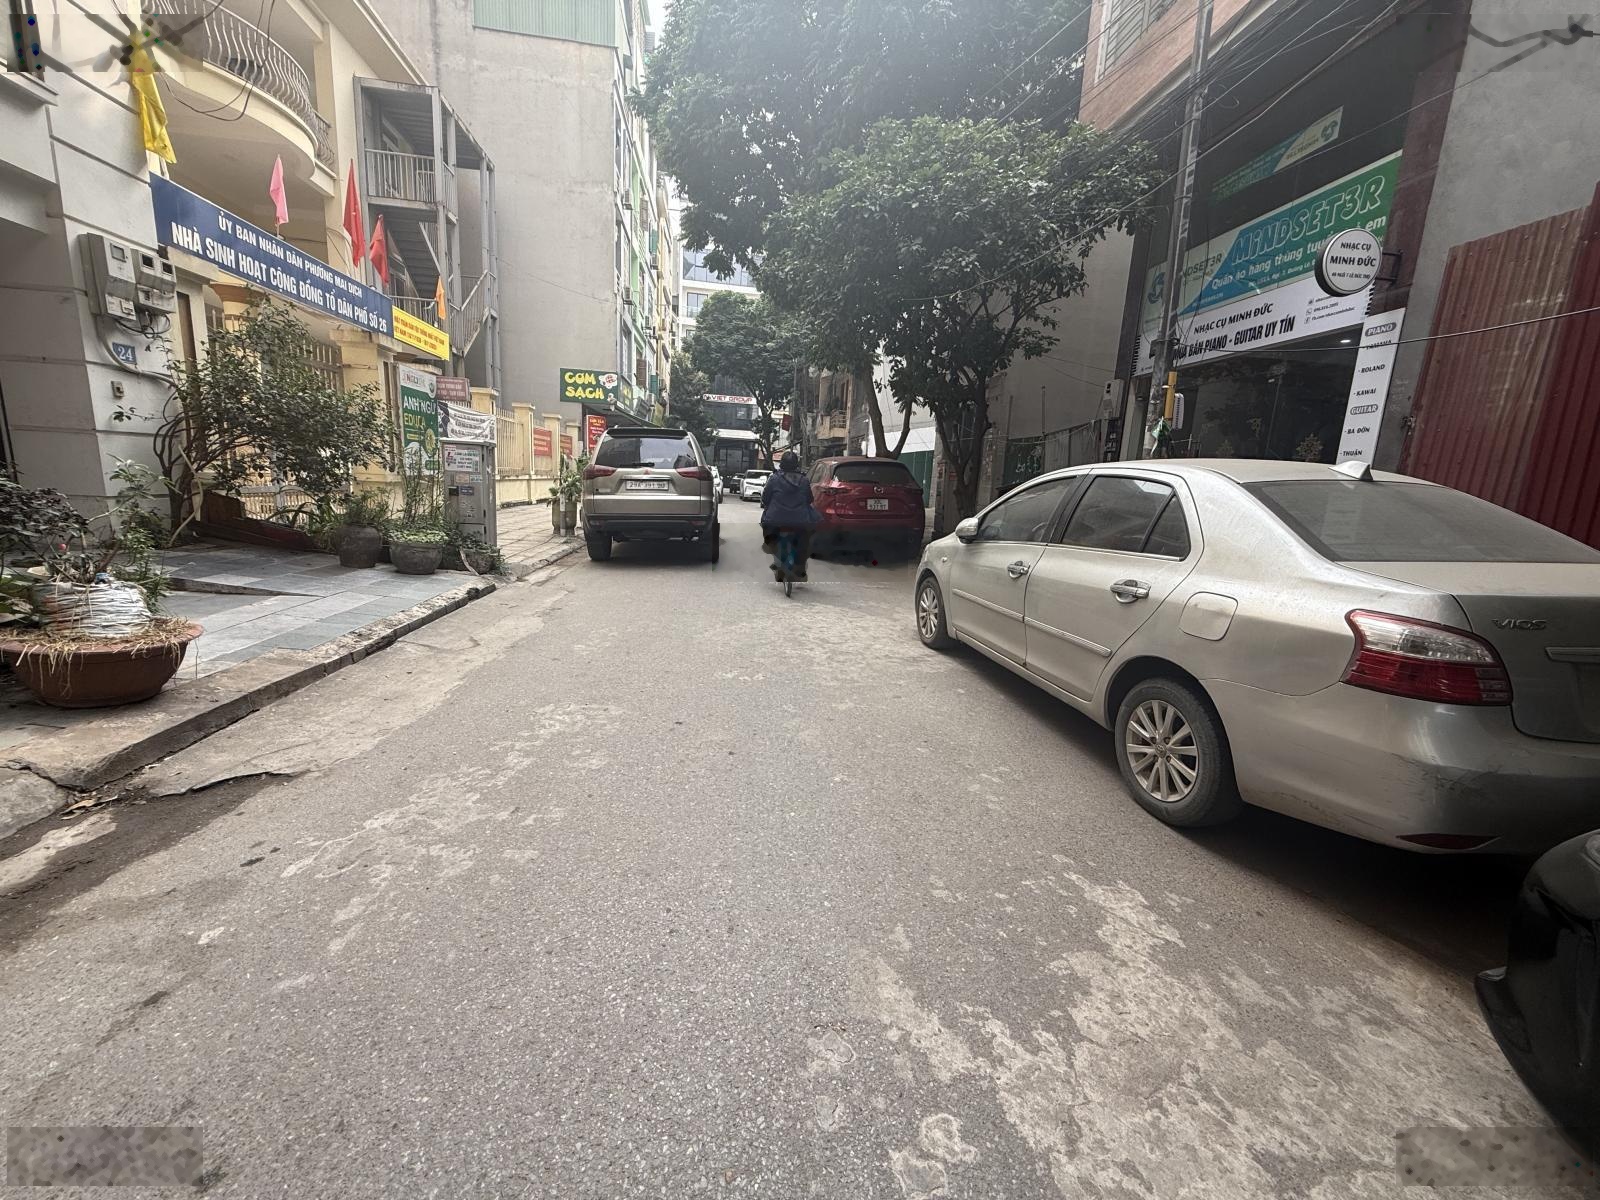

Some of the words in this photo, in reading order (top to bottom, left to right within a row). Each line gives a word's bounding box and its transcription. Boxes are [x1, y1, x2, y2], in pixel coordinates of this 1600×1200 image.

[1365, 215, 1387, 231] em
[218, 210, 233, 234] ỦY
[235, 224, 256, 246] BAN
[259, 235, 284, 260] NHÂN
[286, 250, 303, 269] DÂN
[305, 260, 334, 284] PHƯỜNG
[335, 275, 347, 291] MAI
[1340, 241, 1361, 251] NHẠC
[1361, 243, 1372, 253] CỤ
[1330, 255, 1355, 265] MINH
[1357, 255, 1377, 267] ĐỨC
[171, 221, 203, 255] NHÀ
[205, 237, 236, 269] SINH
[238, 252, 267, 283] HOẠT
[270, 266, 297, 295] CỘNG
[299, 279, 323, 306] ĐỒNG
[325, 289, 336, 311] TỔ
[337, 298, 353, 319] DÂN
[354, 304, 368, 325] PHỐ
[369, 310, 378, 329] SỐ
[379, 317, 387, 332] 26
[1194, 321, 1215, 335] NHẠC
[1215, 317, 1227, 328] CỤ
[1227, 310, 1252, 324] MINH
[1253, 302, 1274, 317] ĐỨC
[1189, 340, 1203, 357] BÁN
[1204, 335, 1228, 353] PIANO
[1233, 324, 1263, 346] GUITAR
[1264, 320, 1278, 338] UY
[1279, 314, 1296, 335] TÍN
[1367, 323, 1393, 336] PIANO
[118, 346, 133, 360] 24
[565, 372, 597, 385] CƠM
[565, 386, 605, 400] SẠCH
[403, 395, 419, 411] ANH
[1351, 405, 1377, 414] GUITAR
[1492, 618, 1547, 631] VIOS
